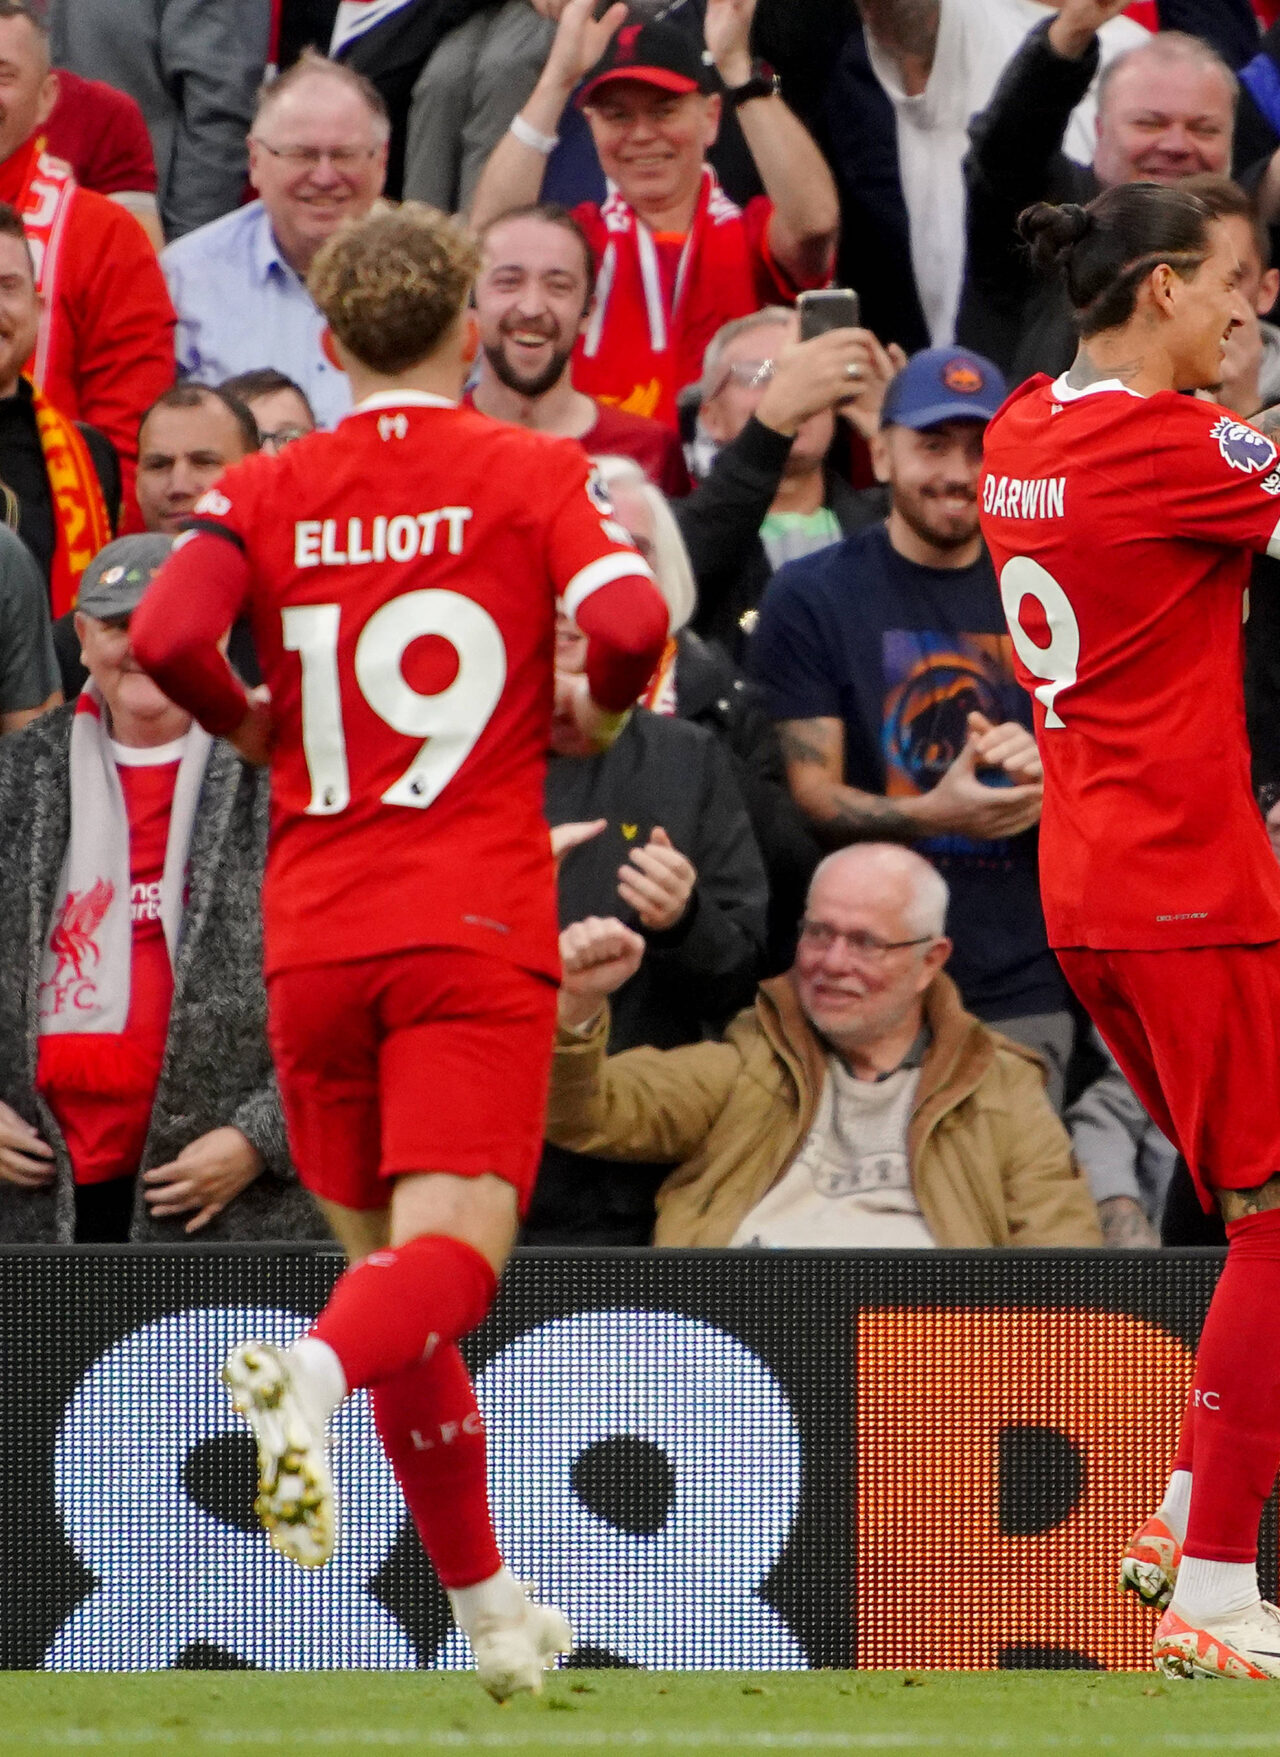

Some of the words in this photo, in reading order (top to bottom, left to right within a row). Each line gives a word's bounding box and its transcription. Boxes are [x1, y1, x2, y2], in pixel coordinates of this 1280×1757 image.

[294, 506, 473, 568] ELLIOTT
[983, 473, 1067, 520] DARWIN
[1000, 555, 1080, 729] 9
[280, 587, 508, 816] 19
